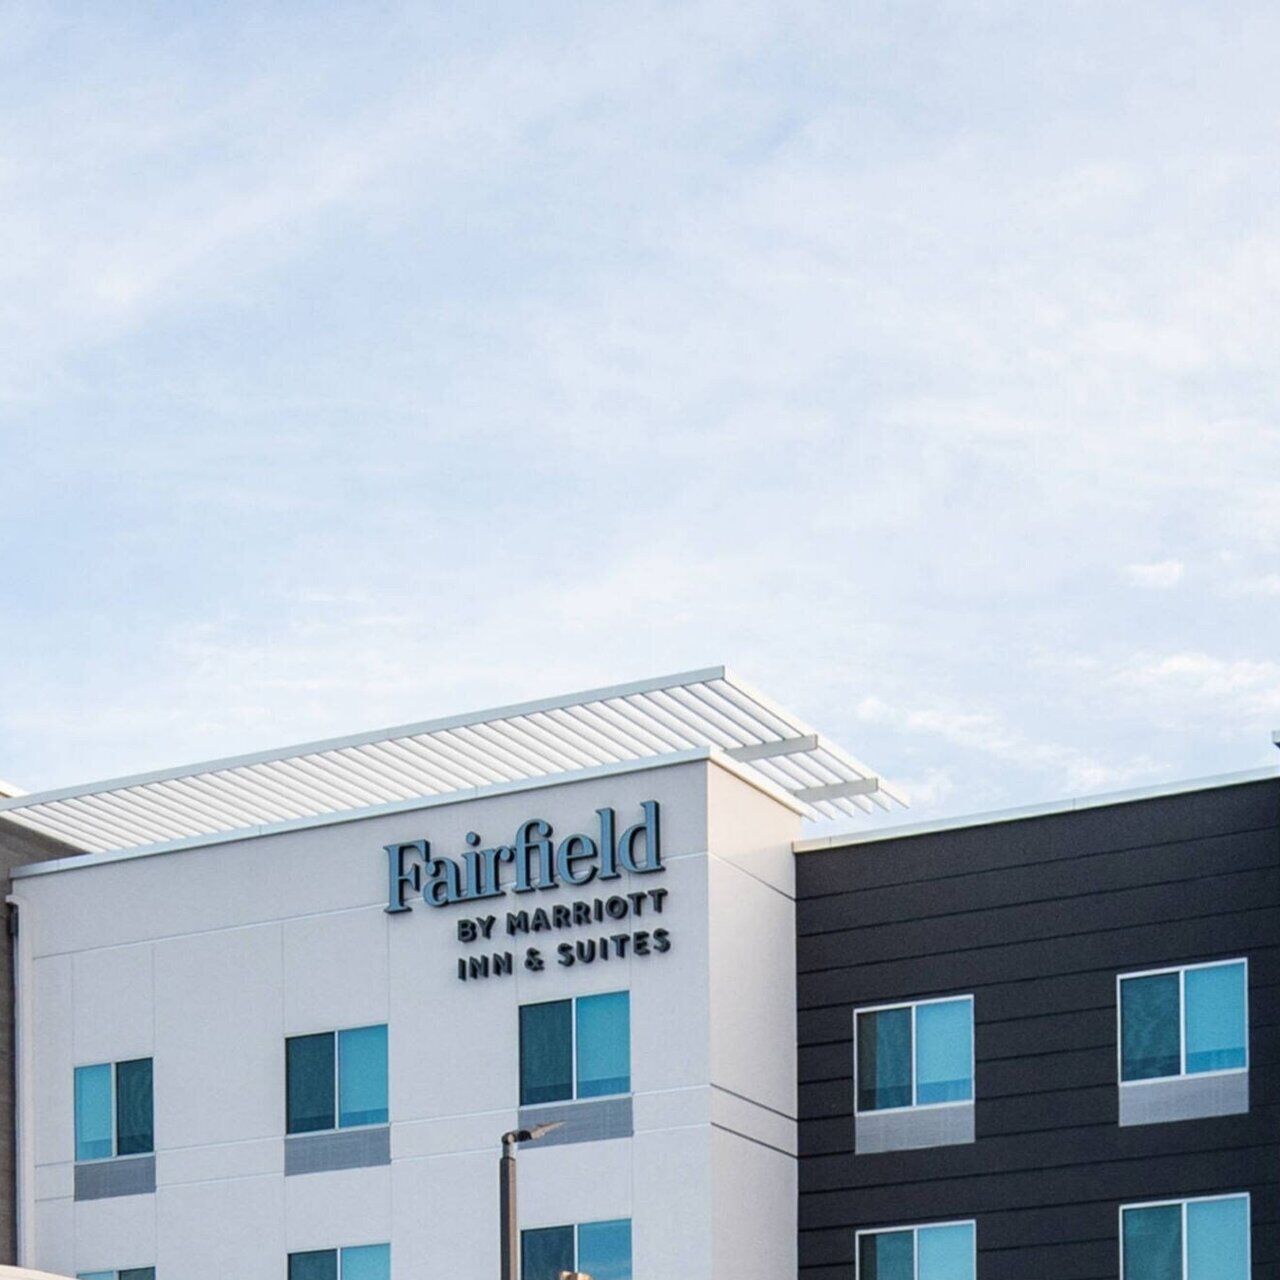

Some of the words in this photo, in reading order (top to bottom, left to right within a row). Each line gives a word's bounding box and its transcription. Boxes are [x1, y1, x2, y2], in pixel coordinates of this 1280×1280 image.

[383, 800, 666, 914] Fairfield
[457, 915, 496, 943] BY
[505, 887, 669, 936] MARRIOTT
[457, 951, 513, 982] INN
[524, 947, 545, 972] &
[558, 927, 672, 967] SUITES
